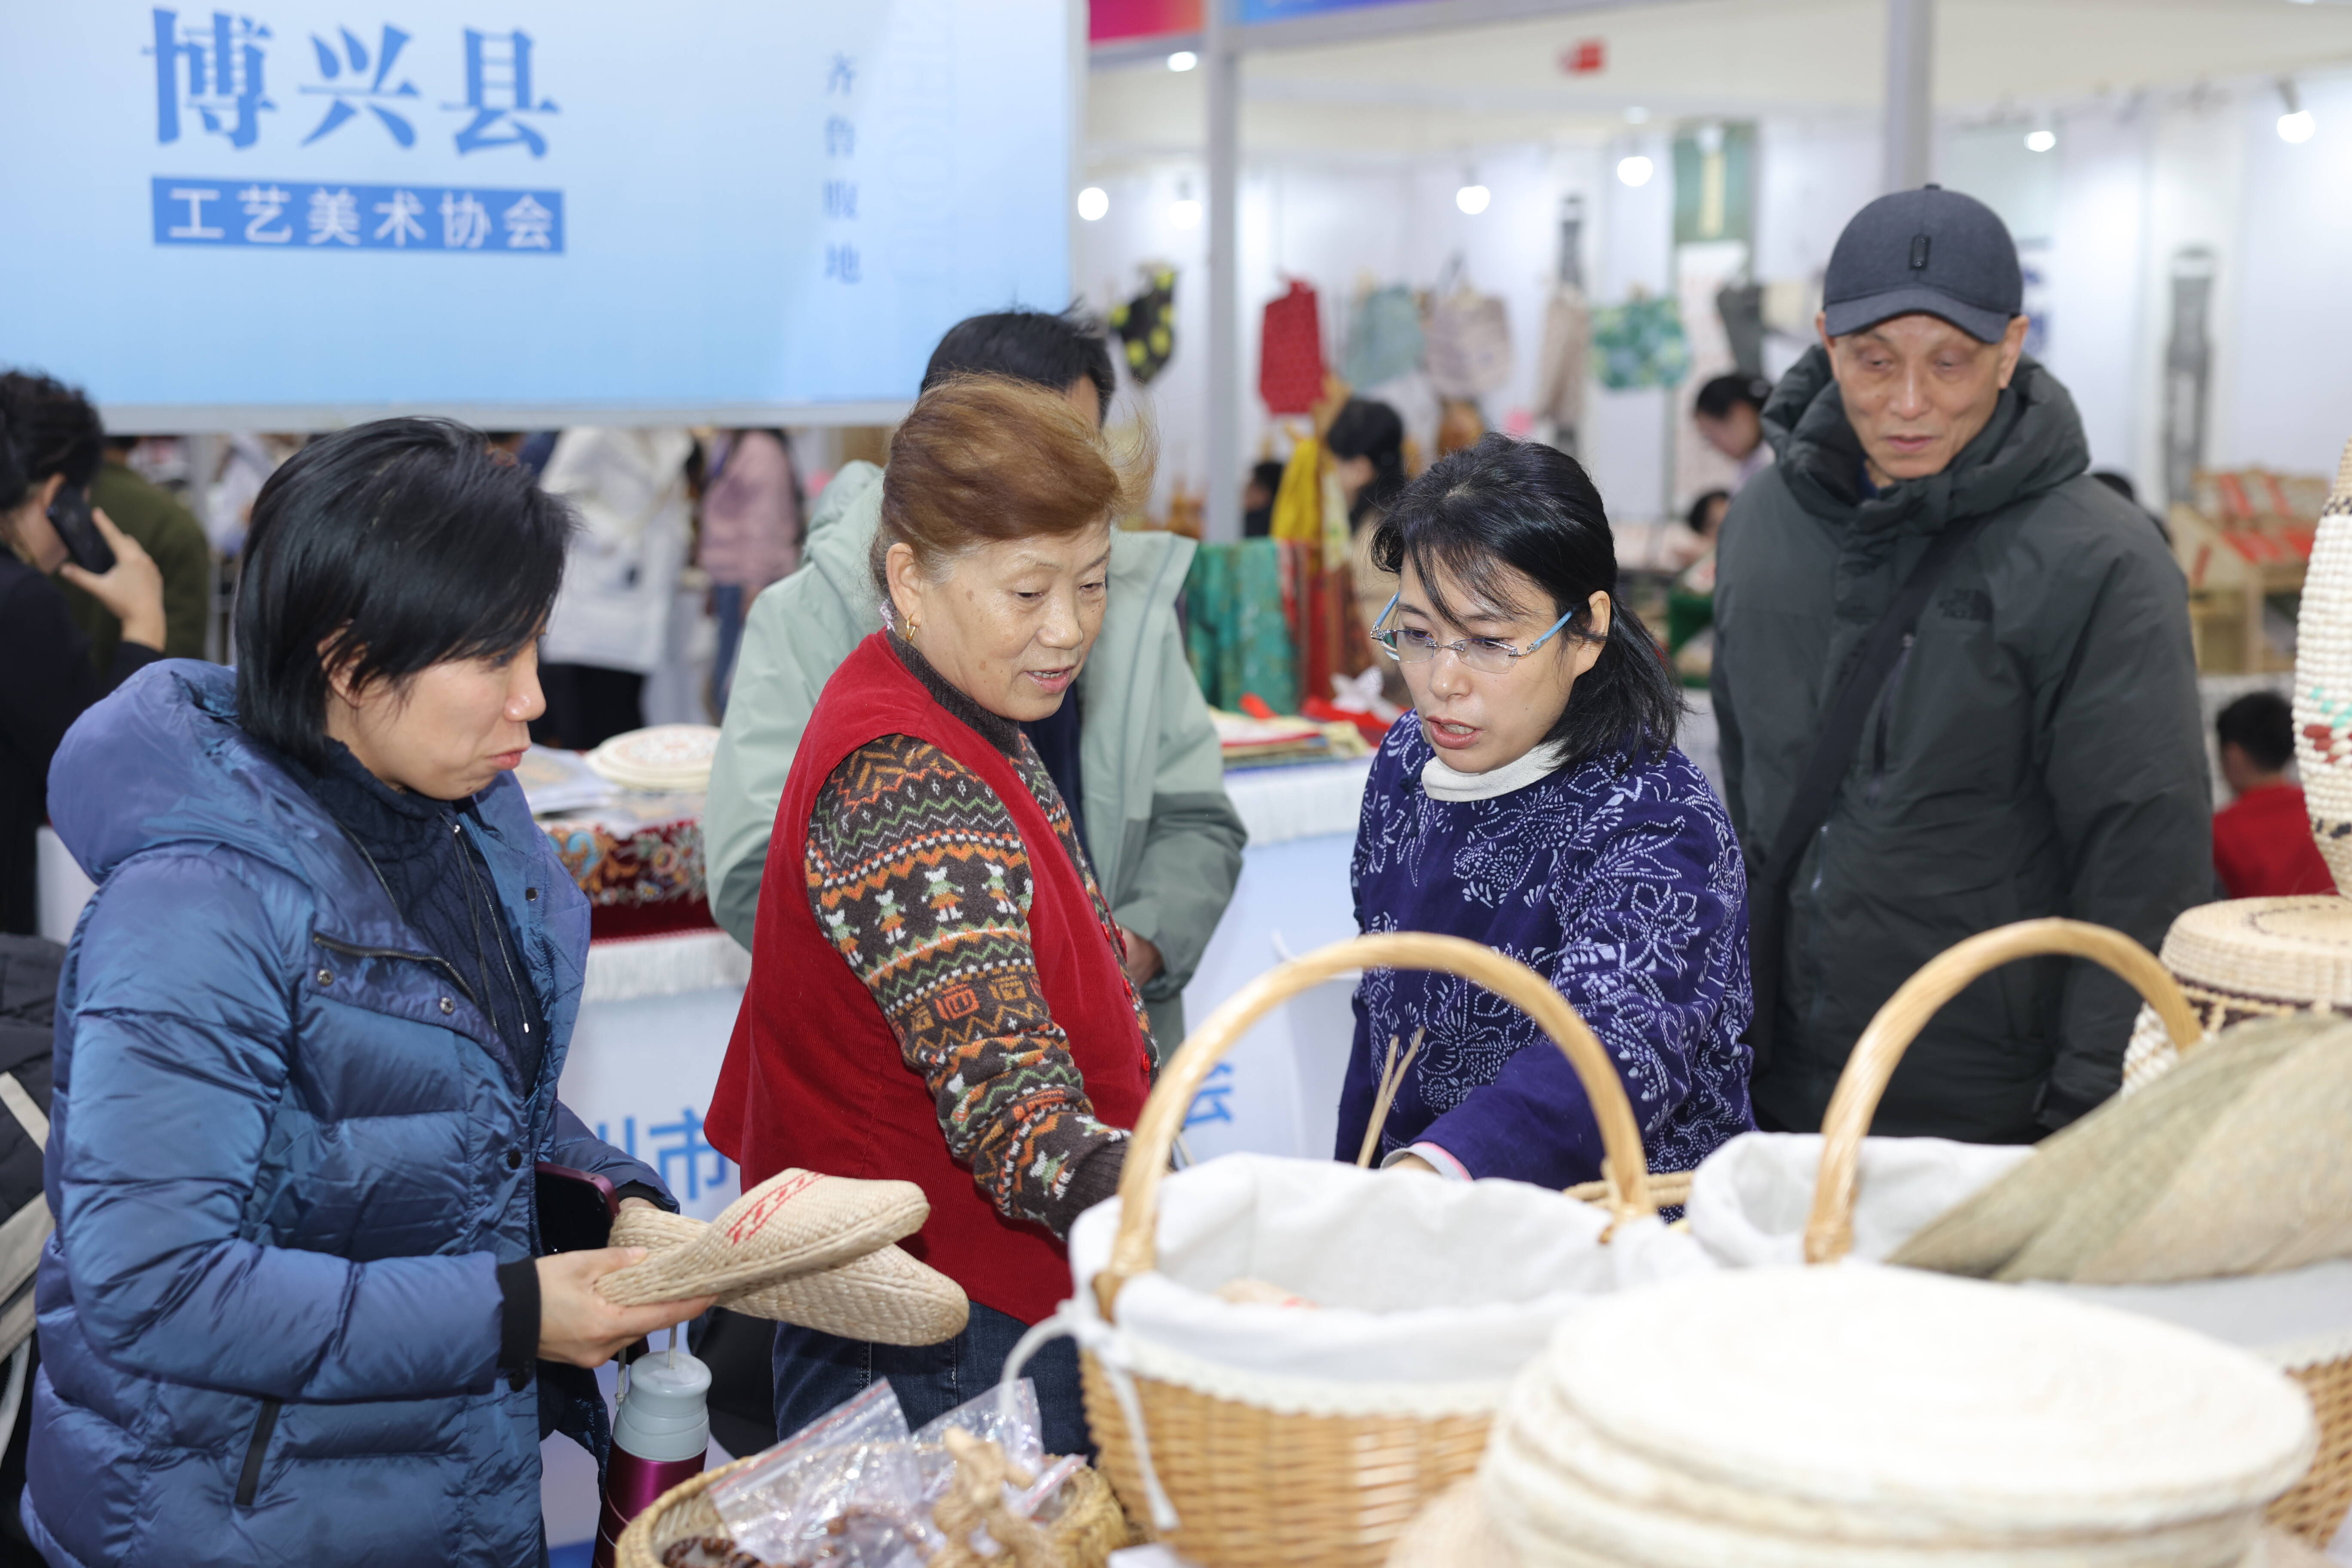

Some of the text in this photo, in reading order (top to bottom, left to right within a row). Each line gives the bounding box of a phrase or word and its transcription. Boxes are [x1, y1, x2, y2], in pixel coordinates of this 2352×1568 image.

[142, 7, 560, 157] 博兴县
[169, 185, 553, 249] 工艺美术协会
